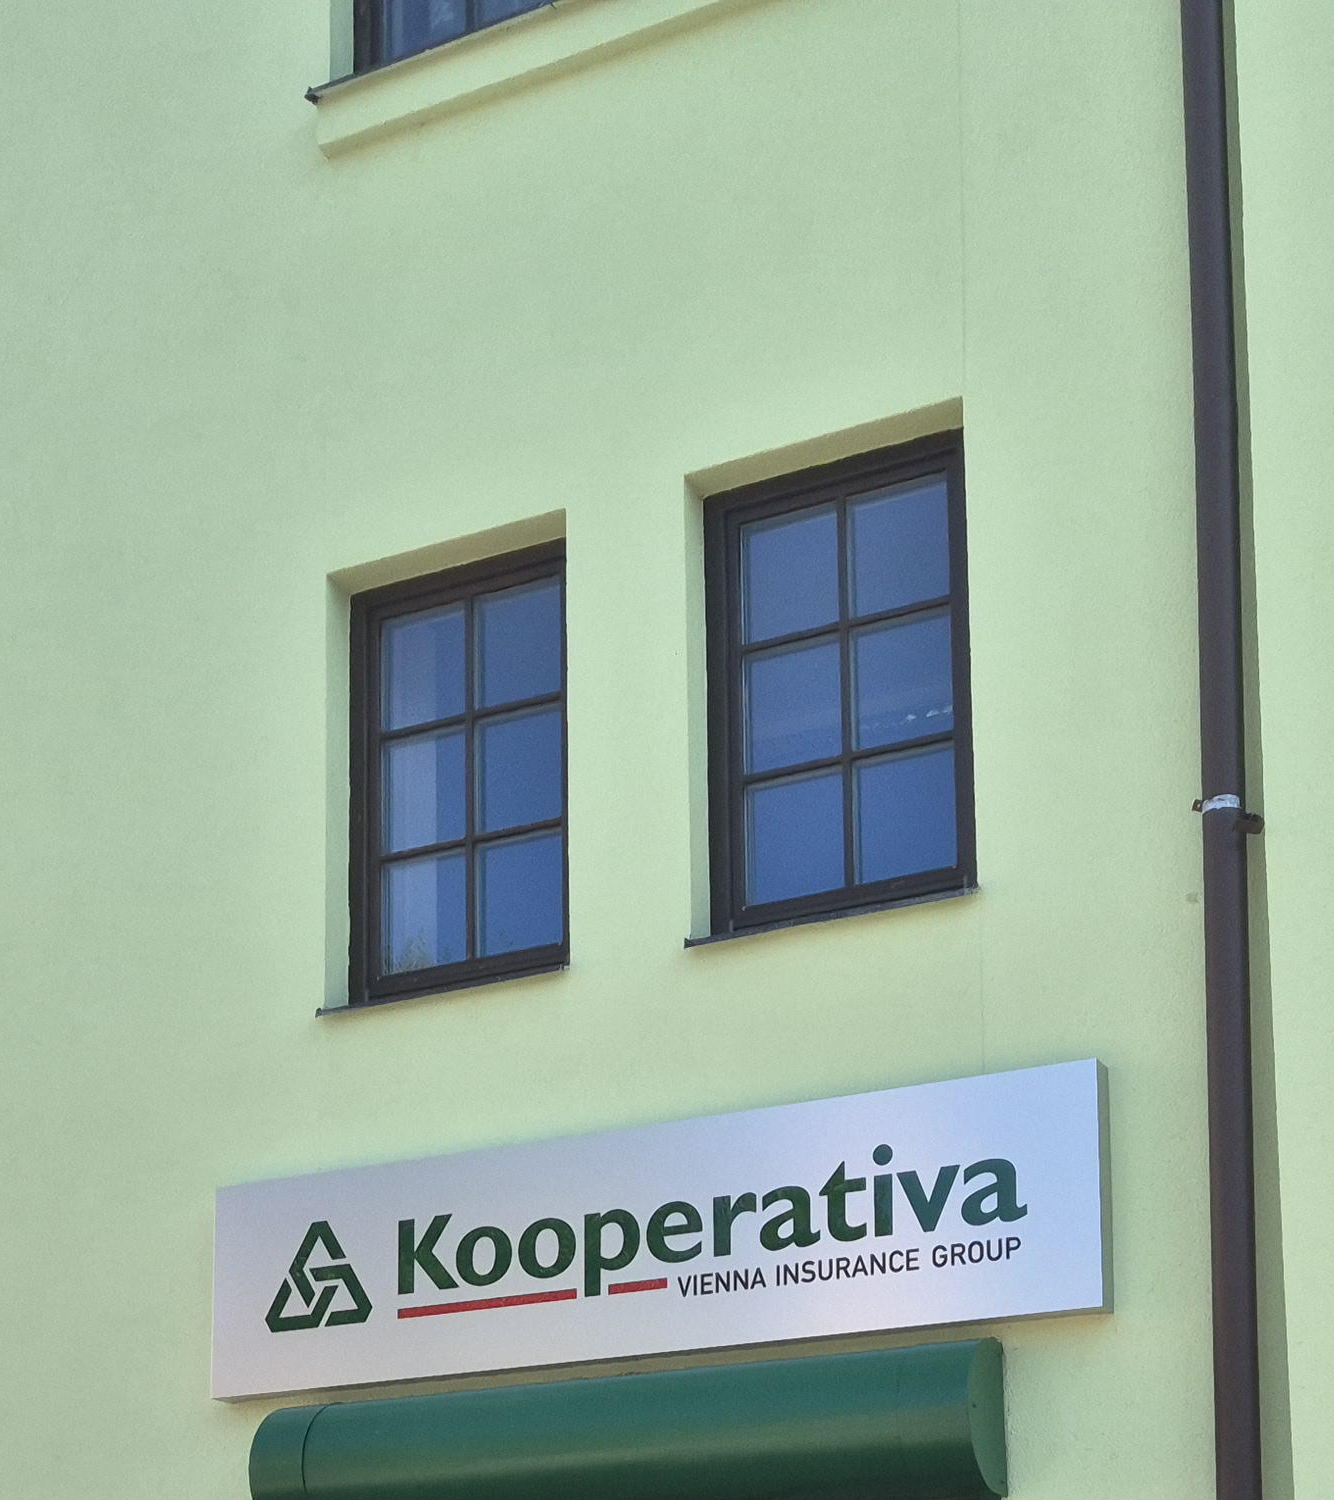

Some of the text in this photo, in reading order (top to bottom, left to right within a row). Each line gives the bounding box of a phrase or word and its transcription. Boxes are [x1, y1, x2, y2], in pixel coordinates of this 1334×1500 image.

[397, 1143, 1028, 1298] Kooperativa
[676, 1236, 1022, 1298] VIENNA INSURANCE GROUP
